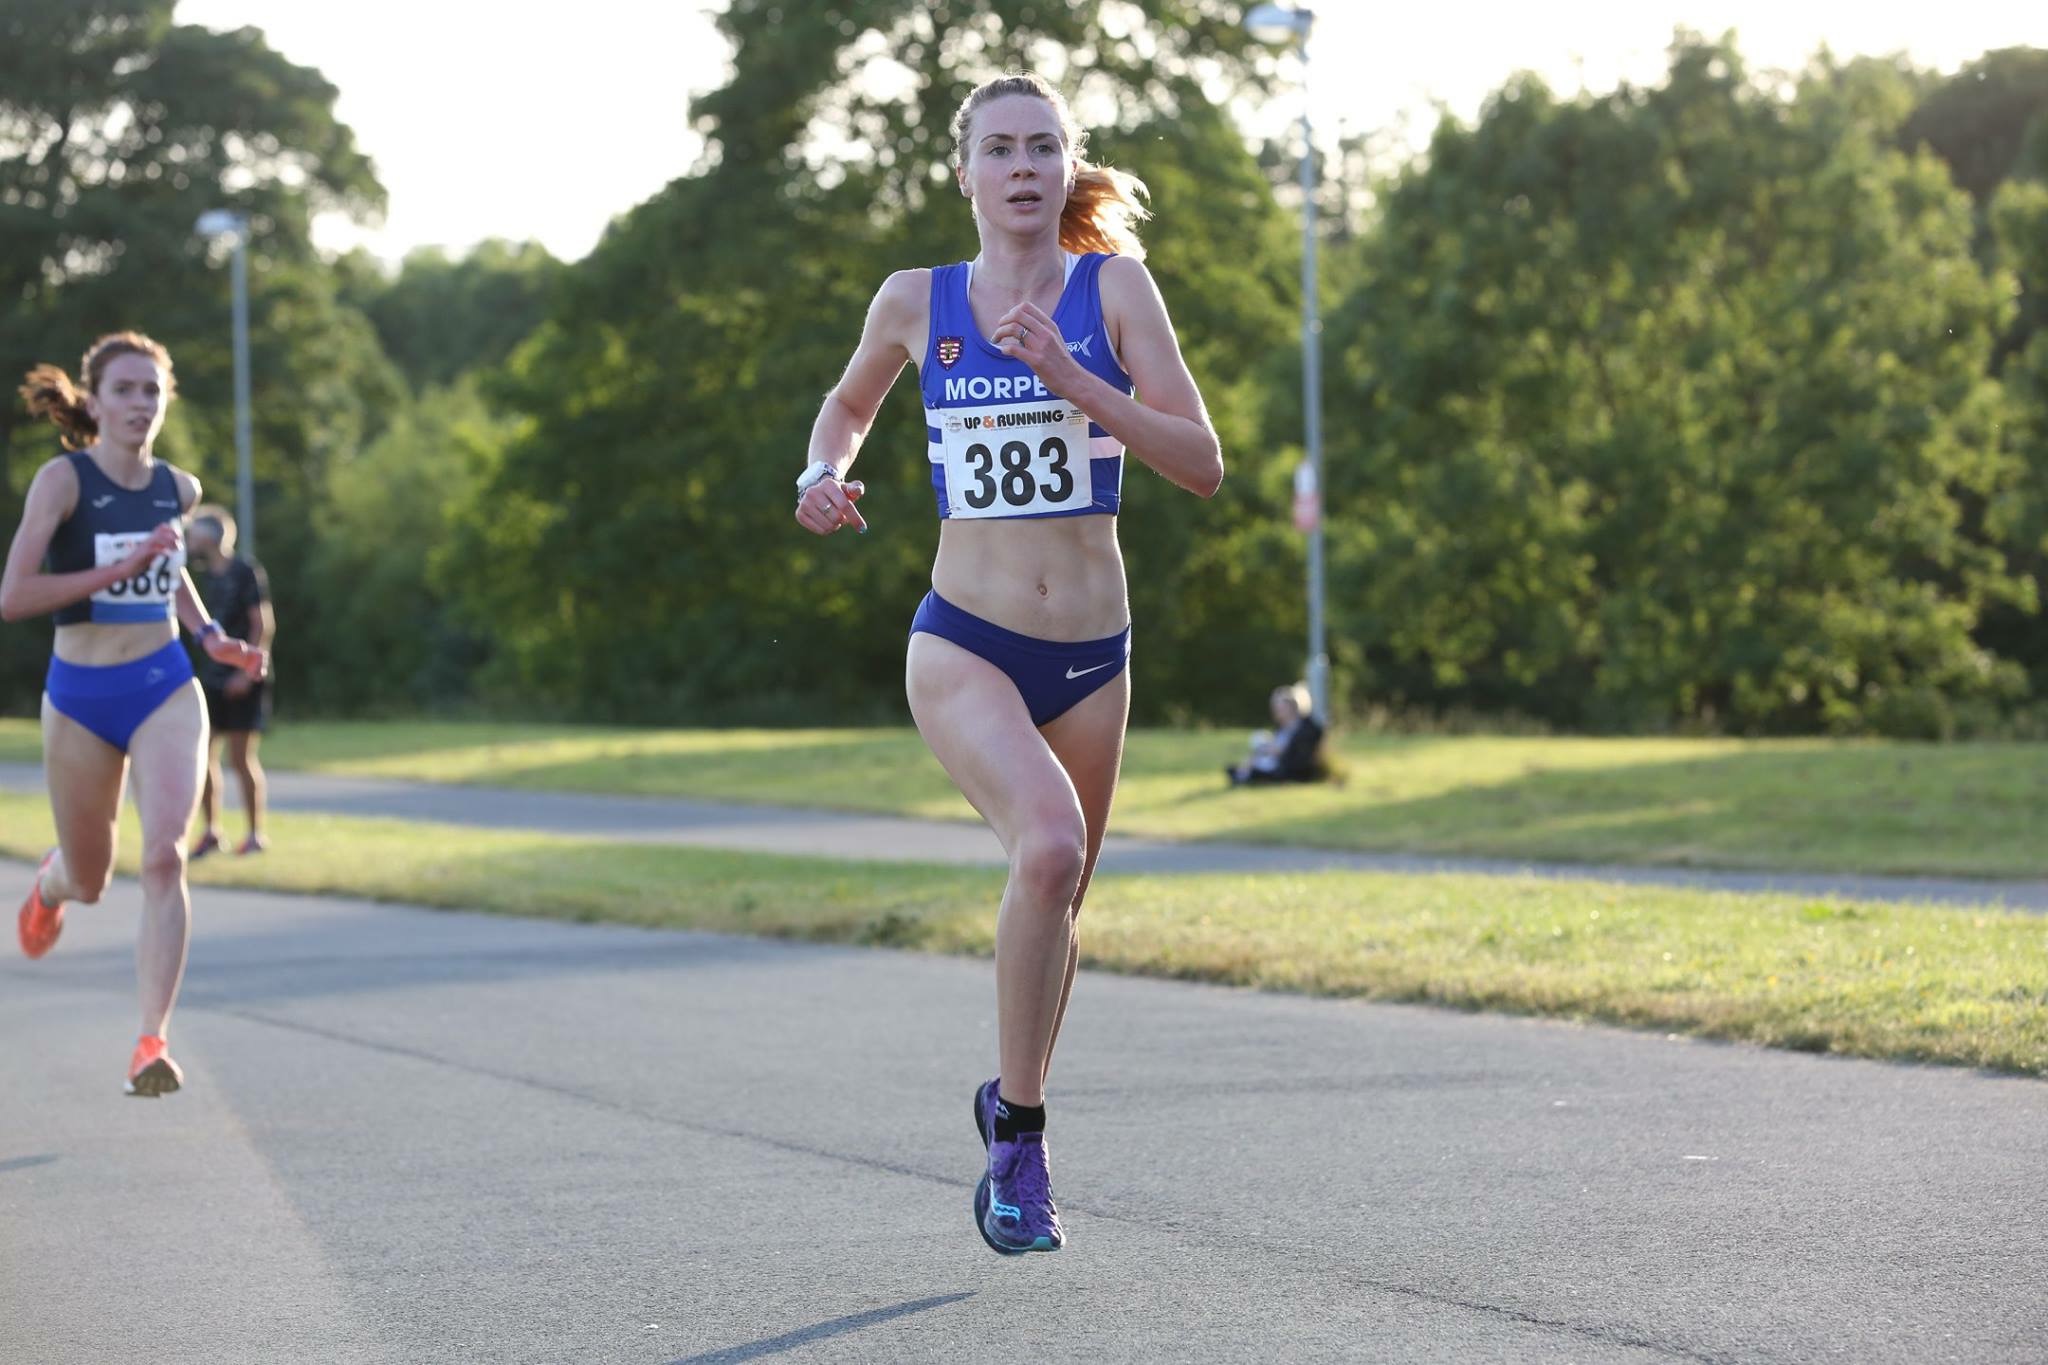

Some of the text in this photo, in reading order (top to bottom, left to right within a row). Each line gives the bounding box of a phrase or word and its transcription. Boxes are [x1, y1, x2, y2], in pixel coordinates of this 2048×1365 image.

[964, 416, 982, 430] UP
[983, 415, 995, 429] &
[997, 409, 1065, 427] RUNNING
[964, 436, 1074, 509] 383
